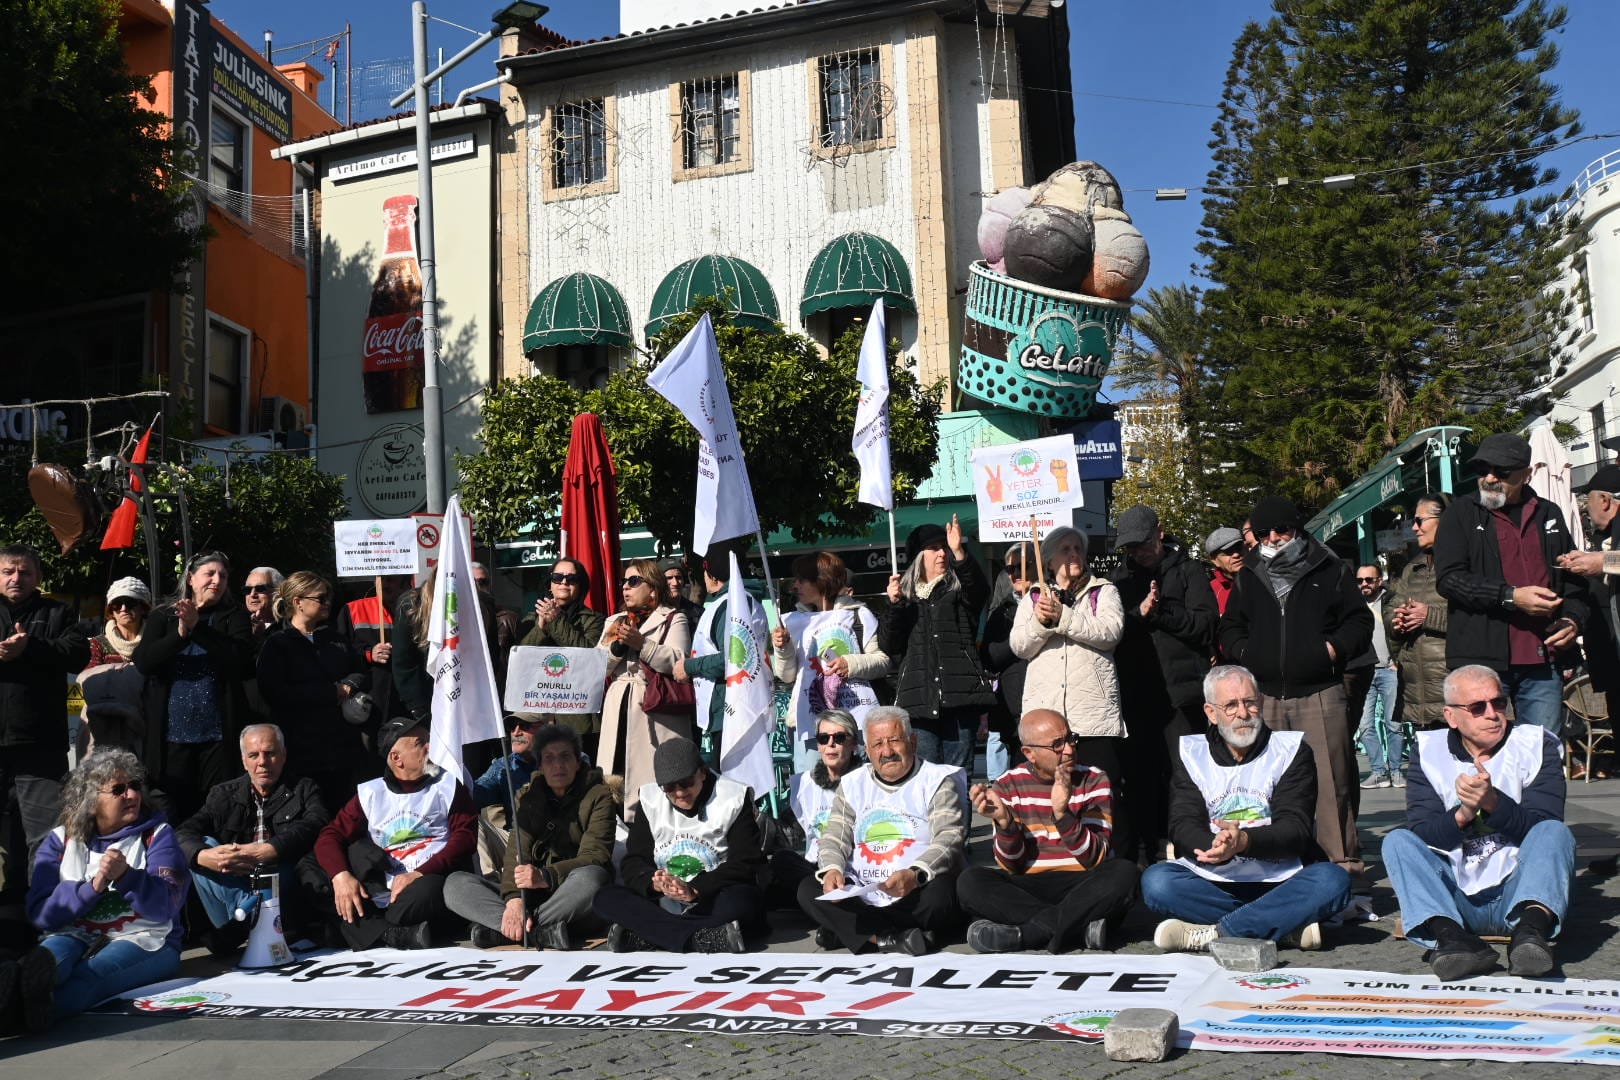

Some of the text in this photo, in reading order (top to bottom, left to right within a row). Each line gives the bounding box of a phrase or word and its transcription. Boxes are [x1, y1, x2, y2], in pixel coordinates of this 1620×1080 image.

[238, 86, 259, 113] DÖVME
[259, 102, 289, 135] STÜDYOSU
[380, 151, 407, 166] Cafe
[1003, 530, 1044, 539] YAPILSN
[537, 682, 572, 690] ONURLU
[524, 691, 589, 701] BİR YAŞAM İÇİN
[523, 701, 587, 709] ALANLARDAYIZ
[566, 964, 688, 983] VE
[694, 963, 1177, 992] SEFALETE
[1343, 980, 1619, 997] TÜM EMEKLİLERİ
[399, 986, 915, 1018] HAYIR!
[259, 1007, 480, 1023] EMEKLİLERİN
[487, 1013, 680, 1028] SENDİKASI
[687, 1017, 861, 1031] ANTALYA
